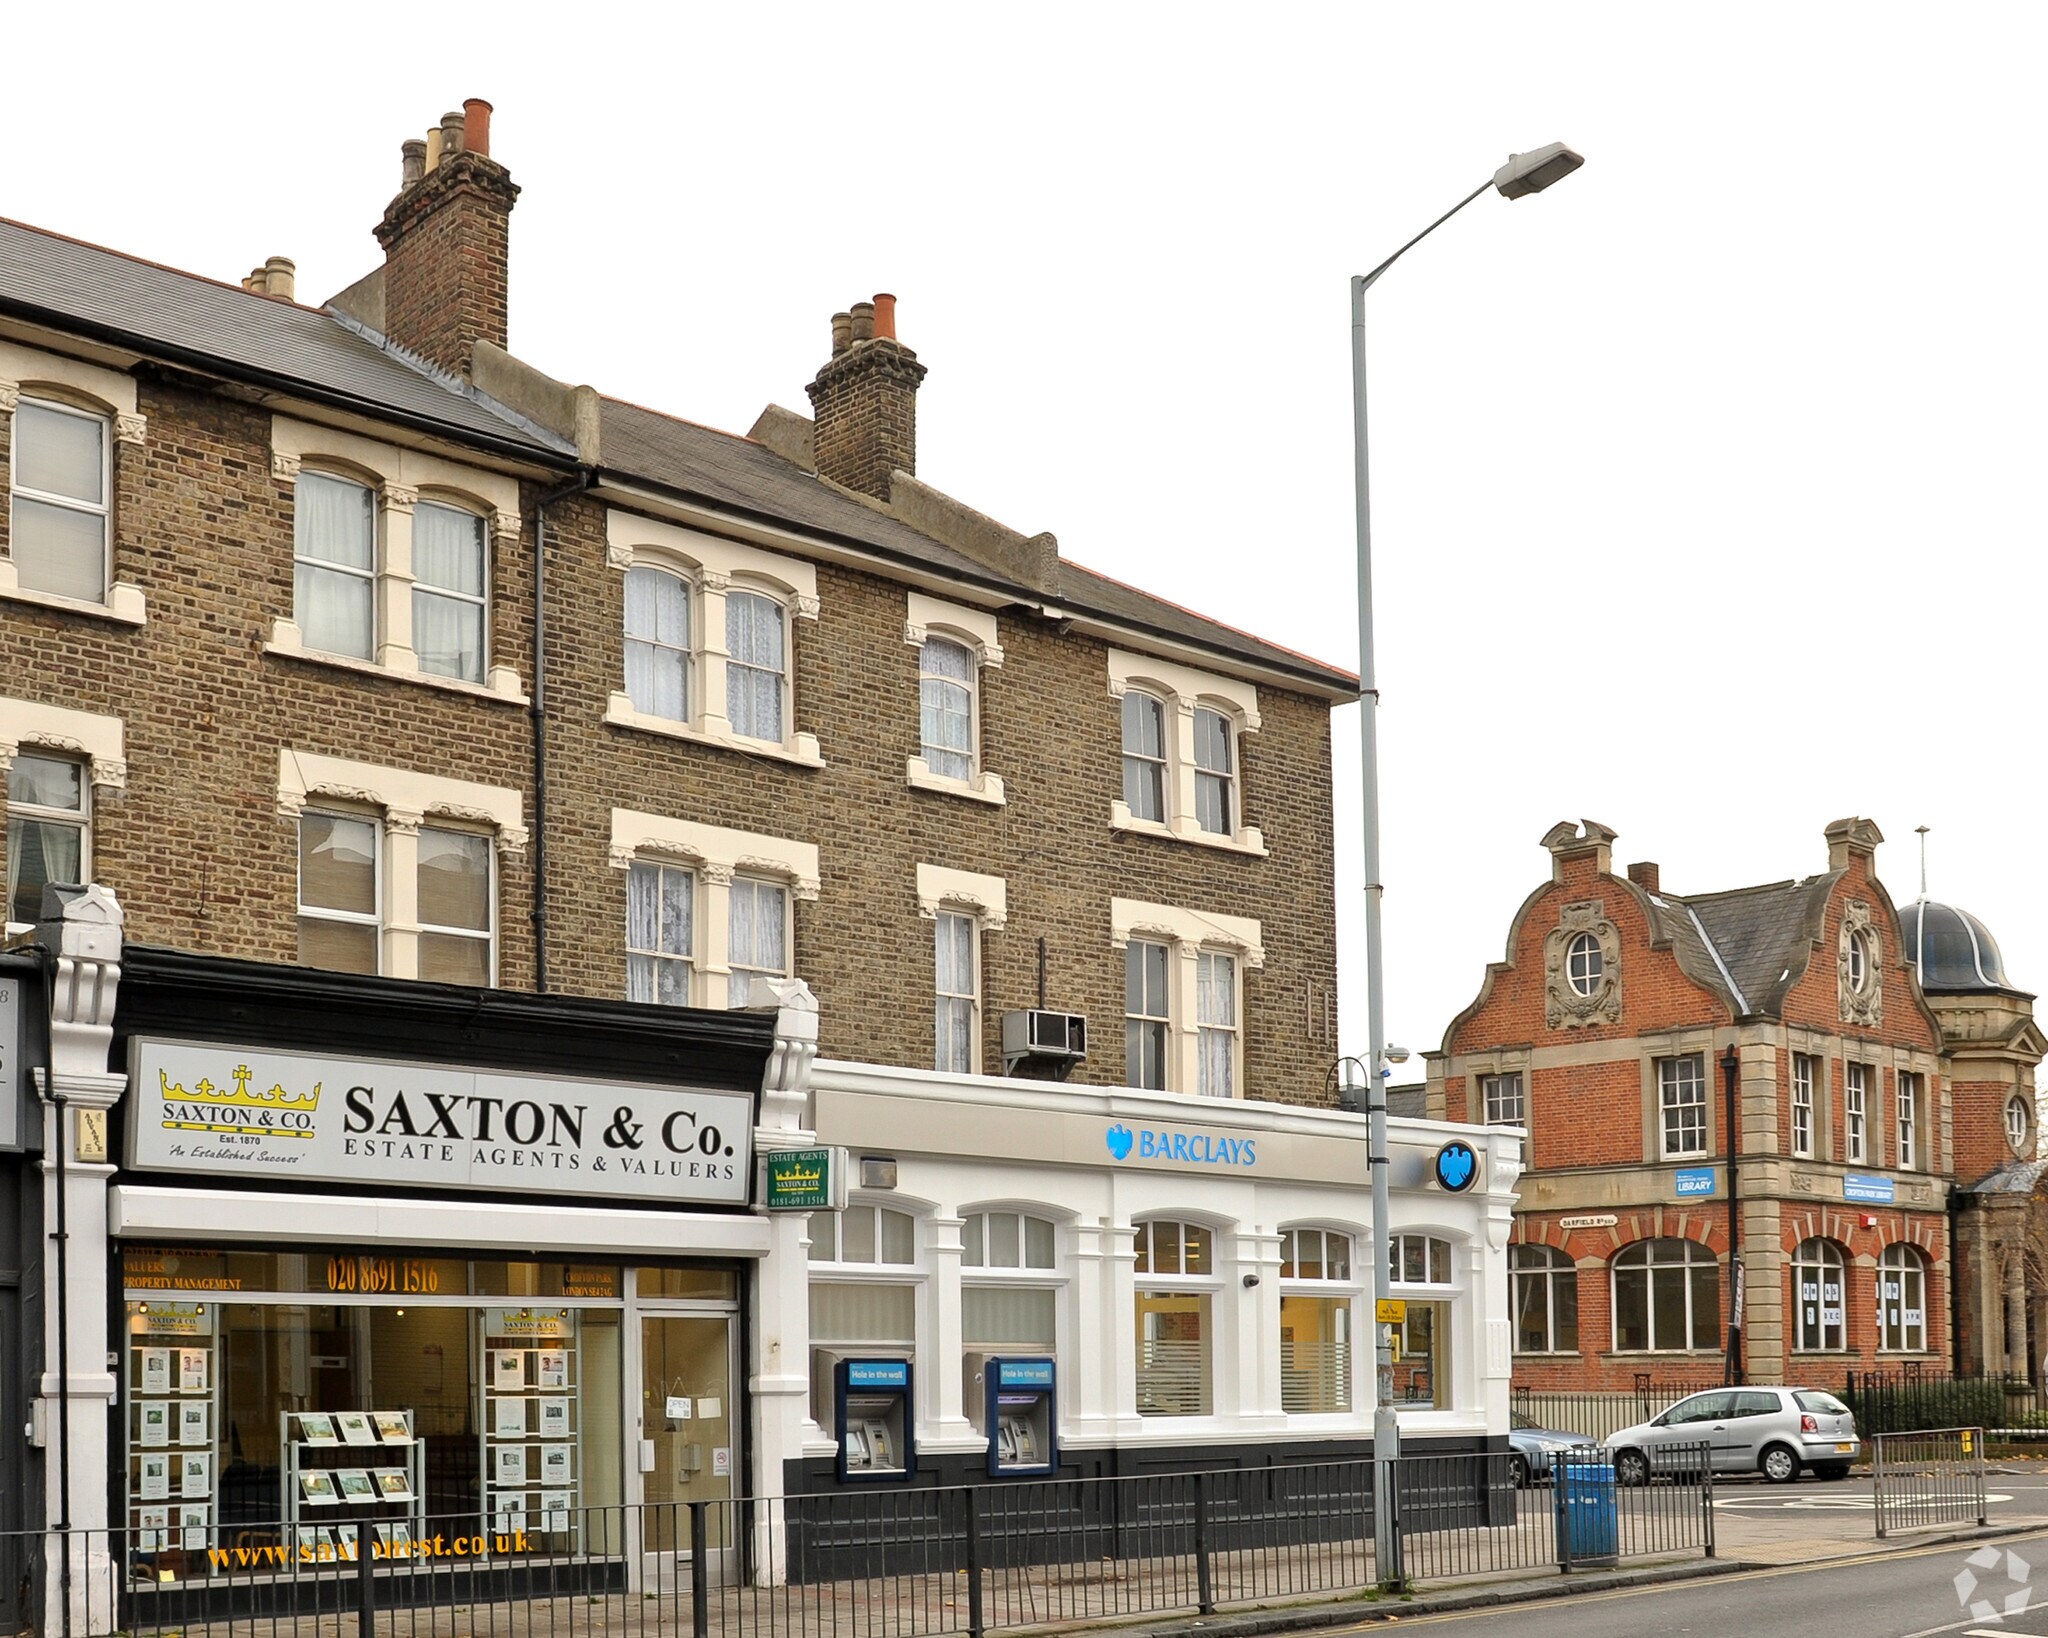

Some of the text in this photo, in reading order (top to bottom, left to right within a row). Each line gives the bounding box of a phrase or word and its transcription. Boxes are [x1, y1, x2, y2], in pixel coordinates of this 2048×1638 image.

[163, 1103, 316, 1129] SAXTON & CO.
[343, 1086, 734, 1157] SAXTON & Co.
[219, 1134, 261, 1145] Est. 1870
[190, 1146, 254, 1161] Established
[1140, 1130, 1256, 1166] BARCLAYS
[344, 1138, 734, 1180] ESTATE AGENTS & VALUERS
[770, 1151, 828, 1162] ESTATE AGENTS
[1678, 1180, 1711, 1191] LIBRARY
[771, 1195, 825, 1206] 0181-691 1516
[327, 1258, 438, 1292] 020 8691 1516
[124, 1276, 241, 1290] PROPERTY MANAGEMENT
[852, 1370, 903, 1379] Hole in the wall
[1002, 1369, 1048, 1378] Hole in the wall
[668, 1399, 690, 1409] OPEN
